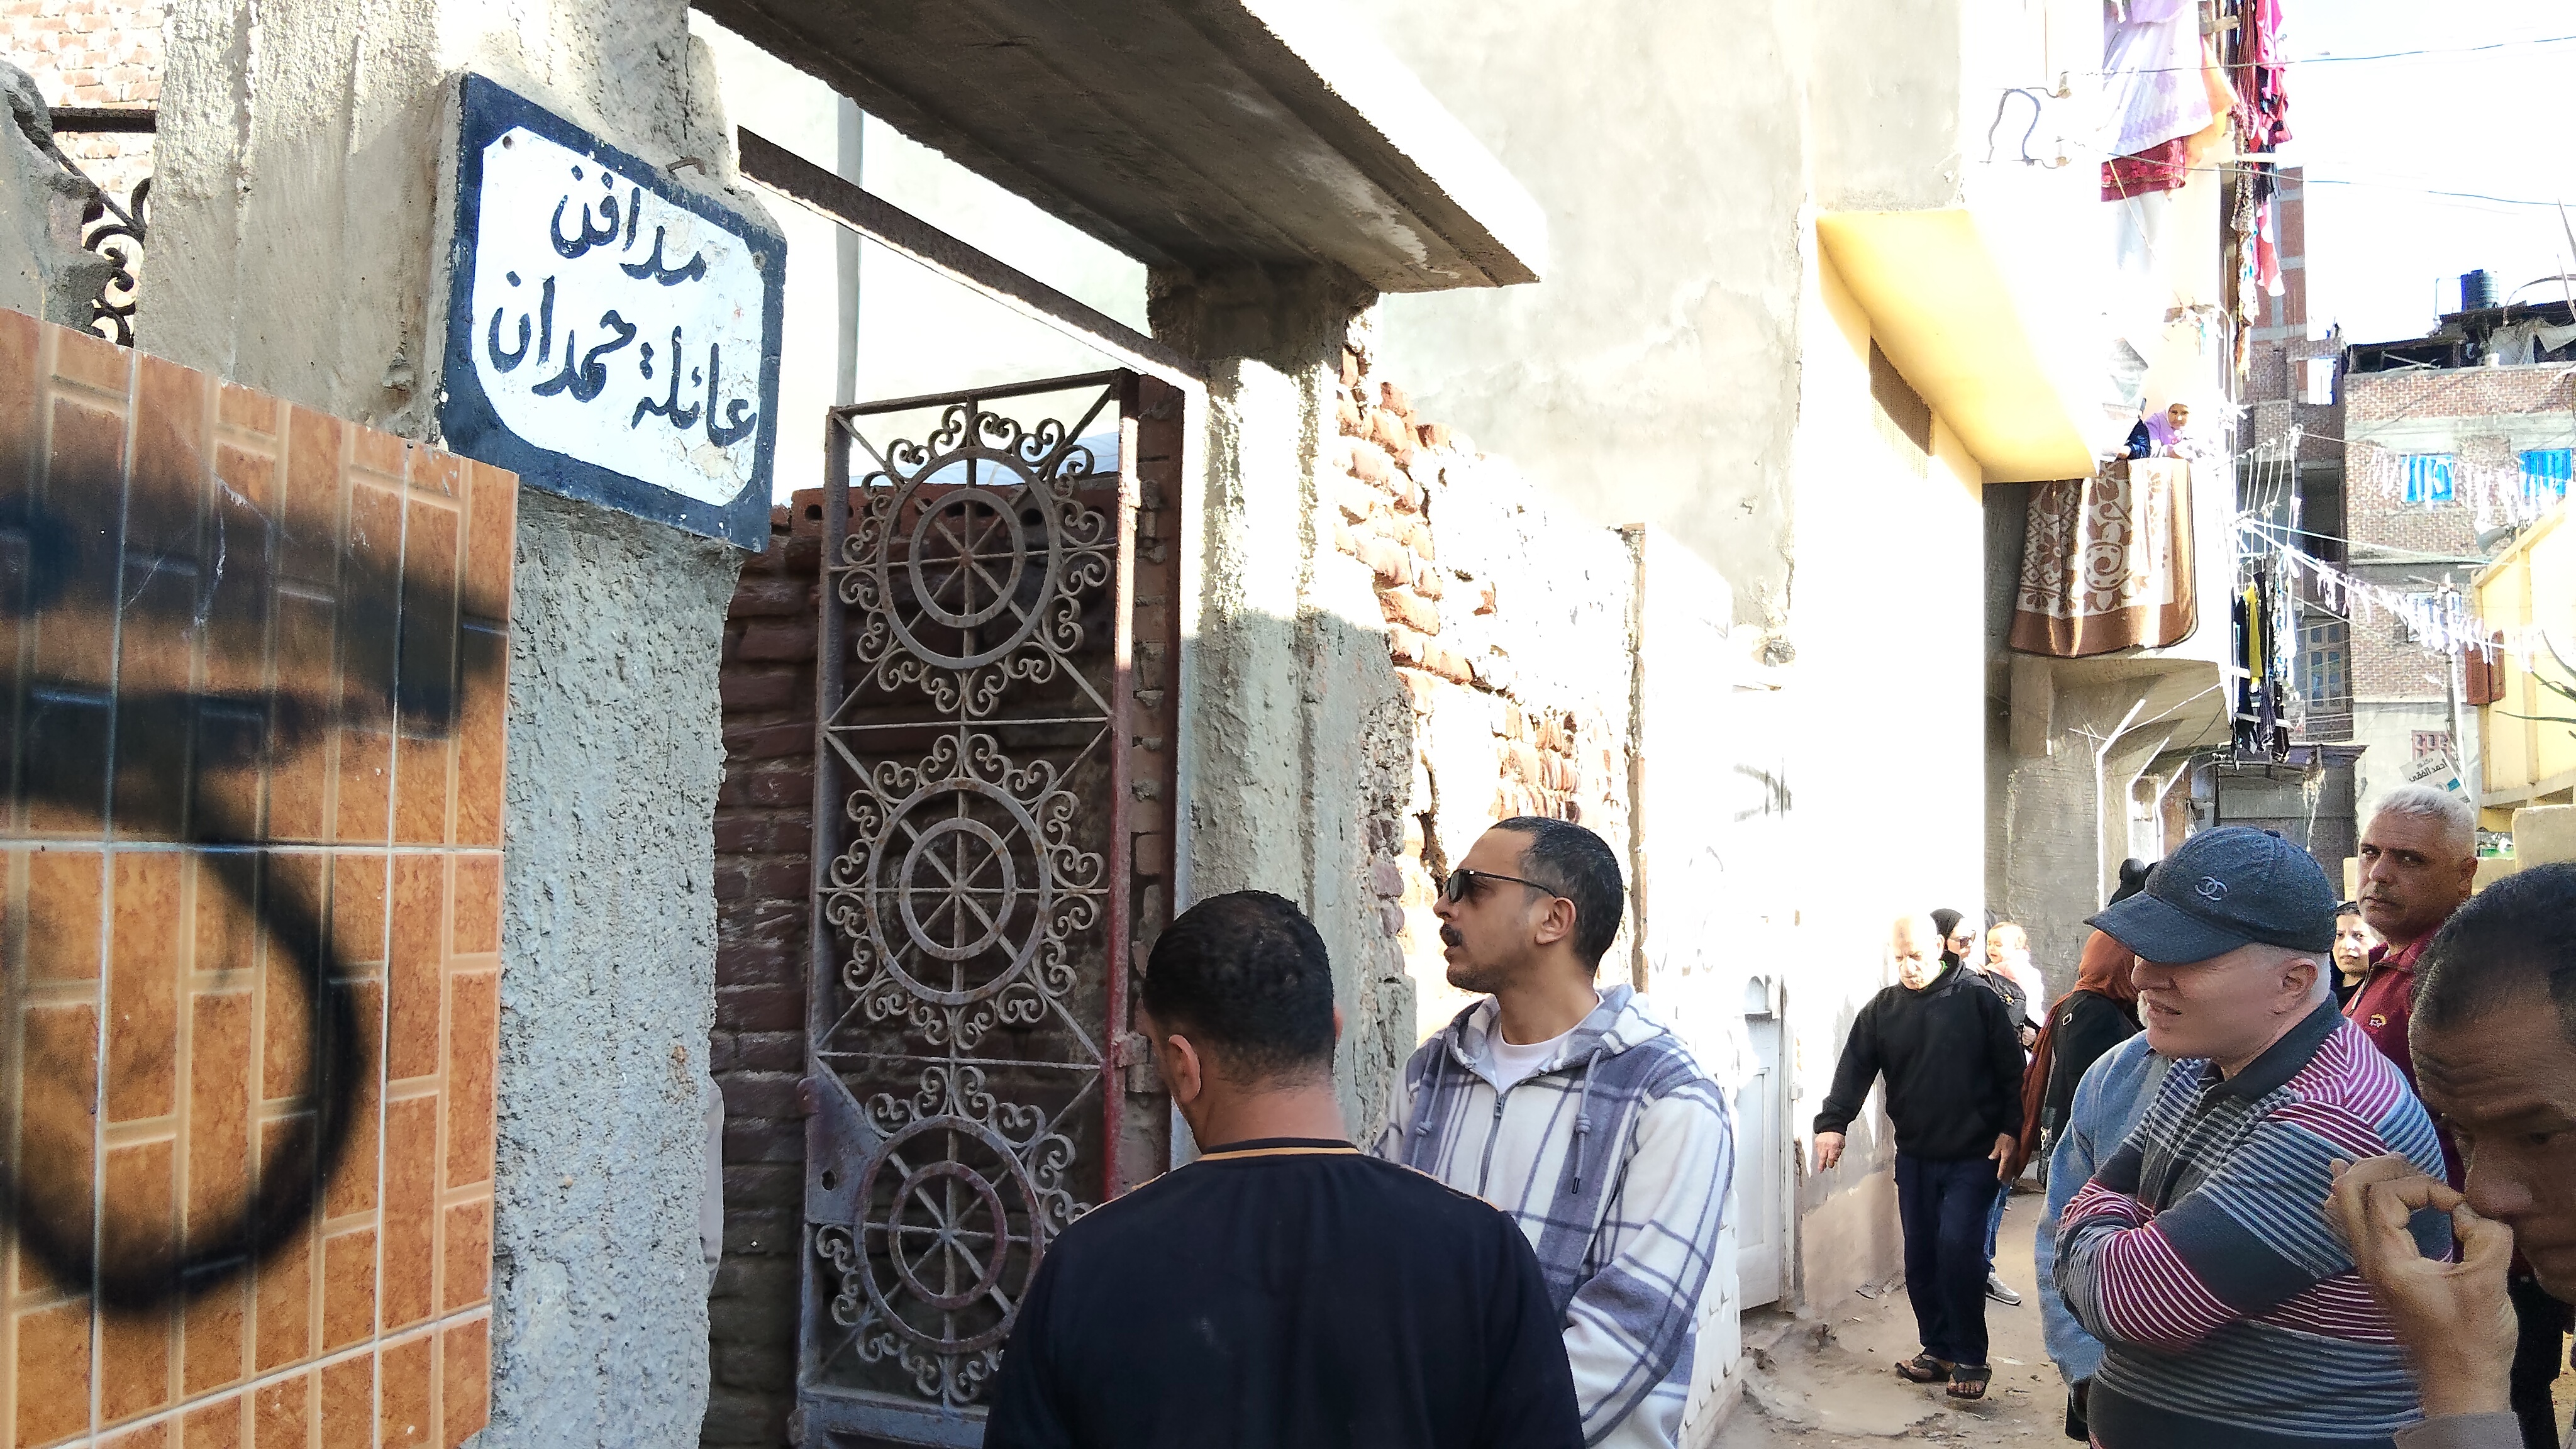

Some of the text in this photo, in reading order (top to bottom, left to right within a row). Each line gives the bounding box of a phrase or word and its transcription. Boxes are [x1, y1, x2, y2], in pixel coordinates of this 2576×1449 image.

[551, 165, 706, 286] مدافن
[487, 270, 758, 447] عائلة حمدان
